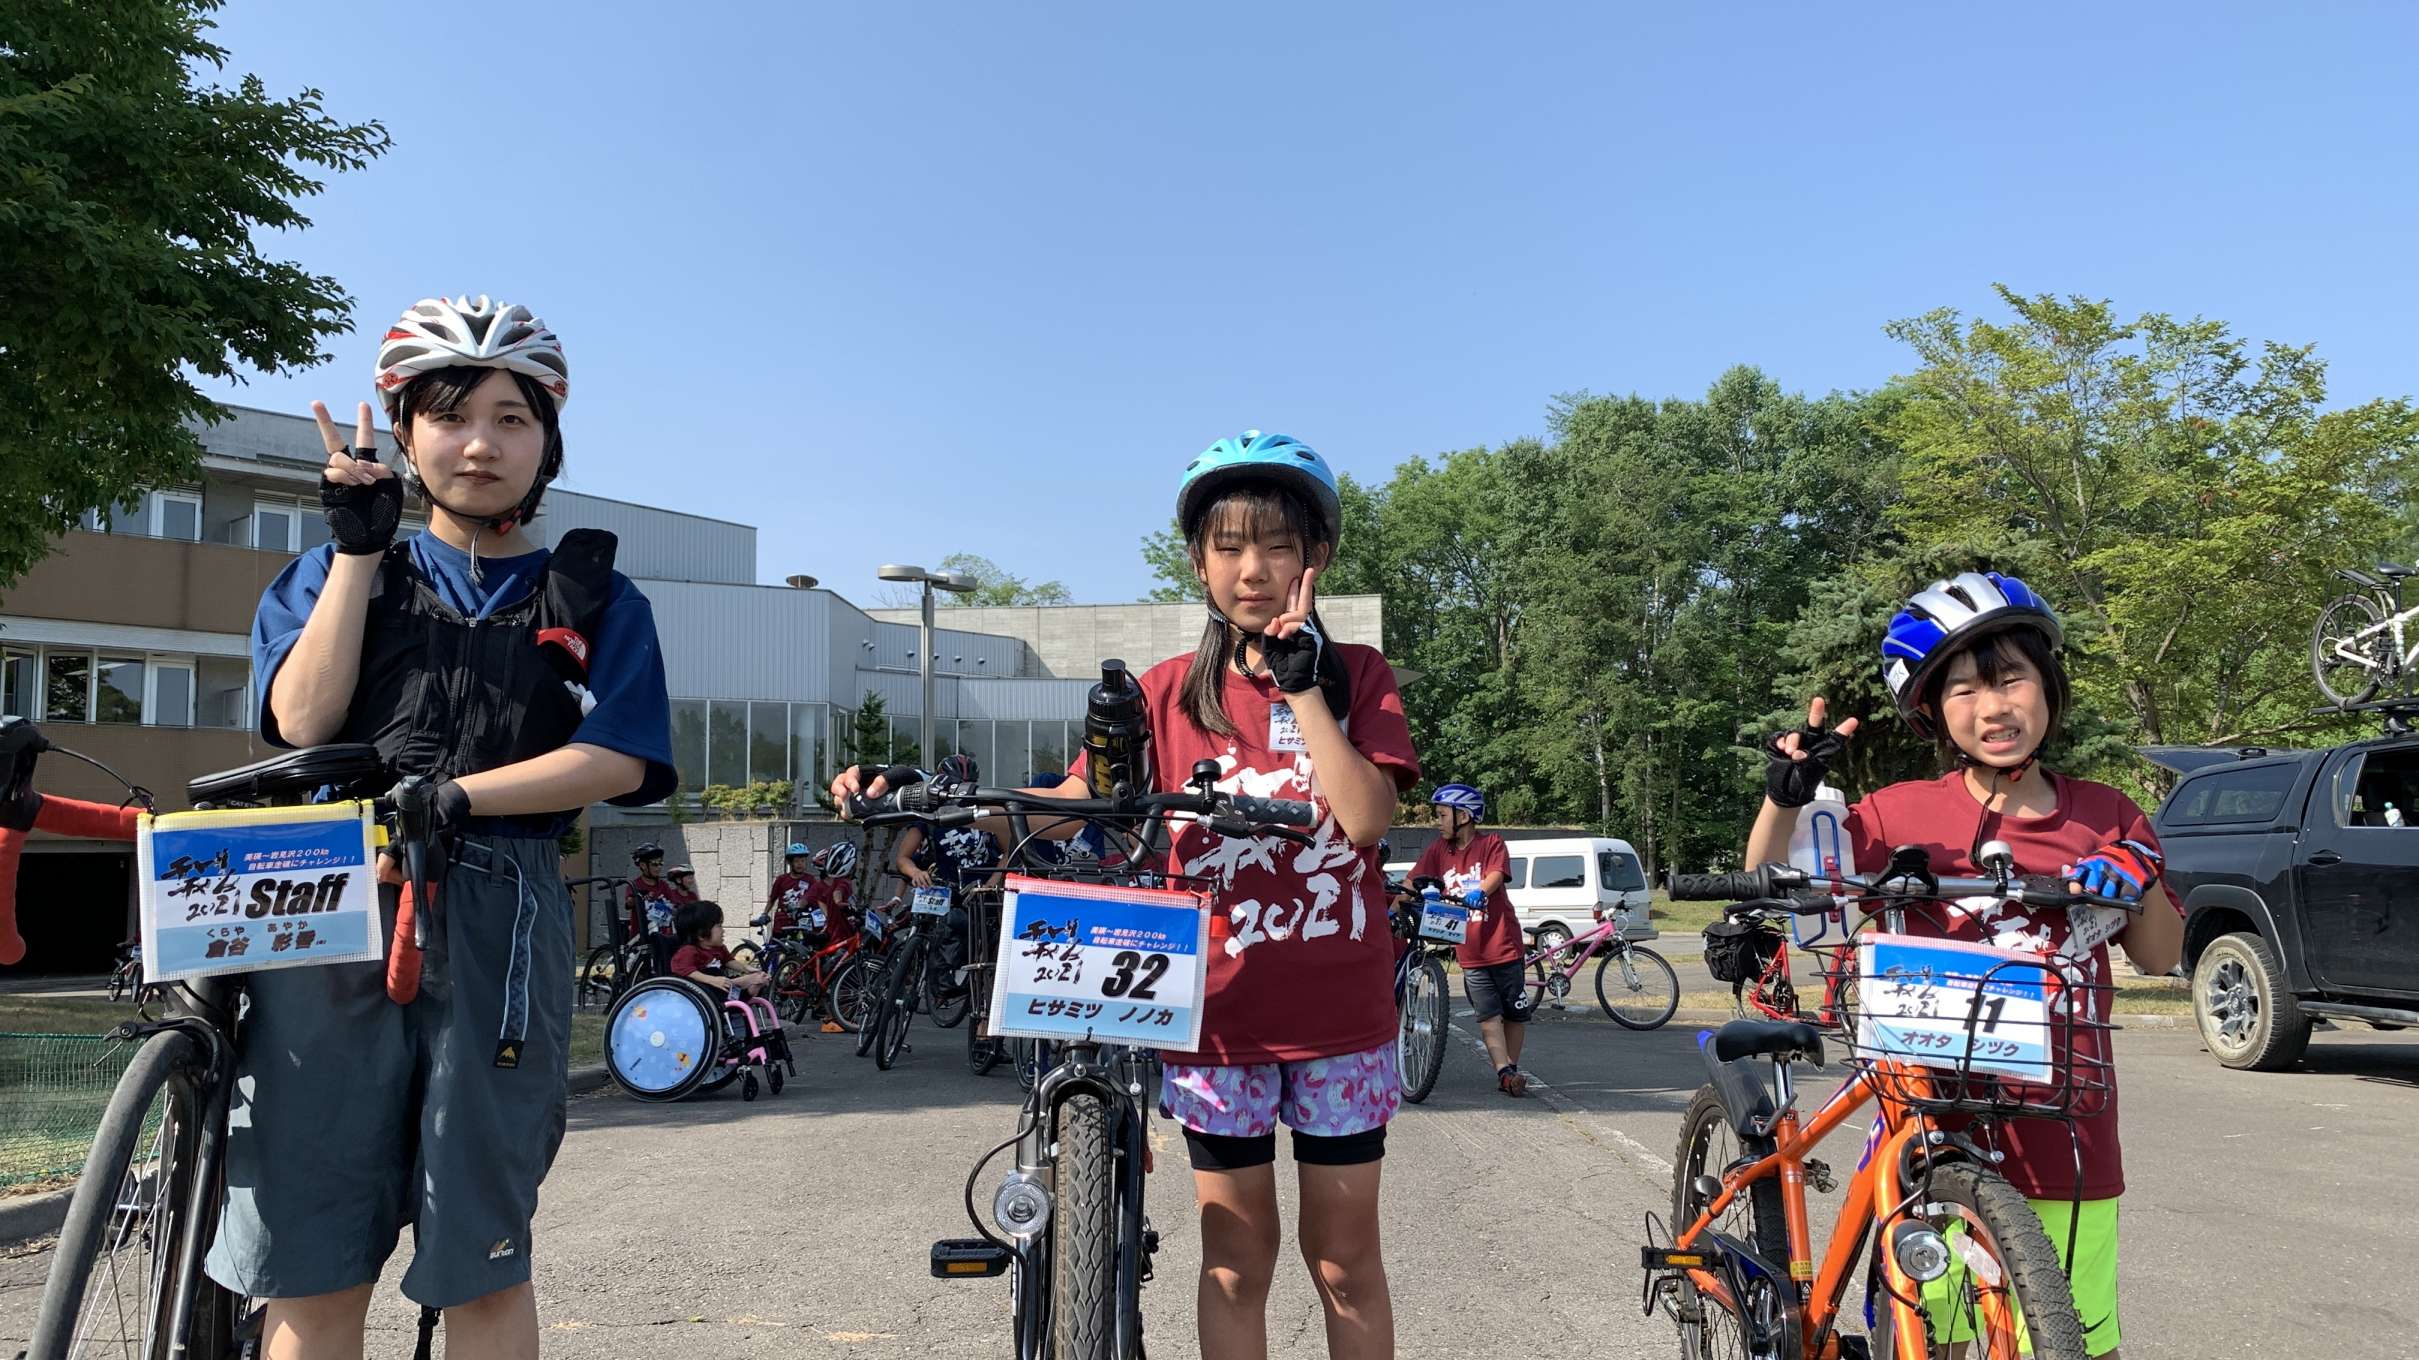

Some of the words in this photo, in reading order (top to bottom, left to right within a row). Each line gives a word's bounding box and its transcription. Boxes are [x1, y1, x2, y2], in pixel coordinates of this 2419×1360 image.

[245, 873, 350, 919] Staff
[1225, 858, 1366, 959] 2021
[1444, 919, 1460, 931] 41
[1101, 950, 1170, 1000] 32
[1028, 999, 1103, 1020] ヒサミツ
[1119, 1007, 1174, 1027] ノノカ
[1962, 994, 2007, 1034] 11
[1901, 1031, 1952, 1048] オオタ
